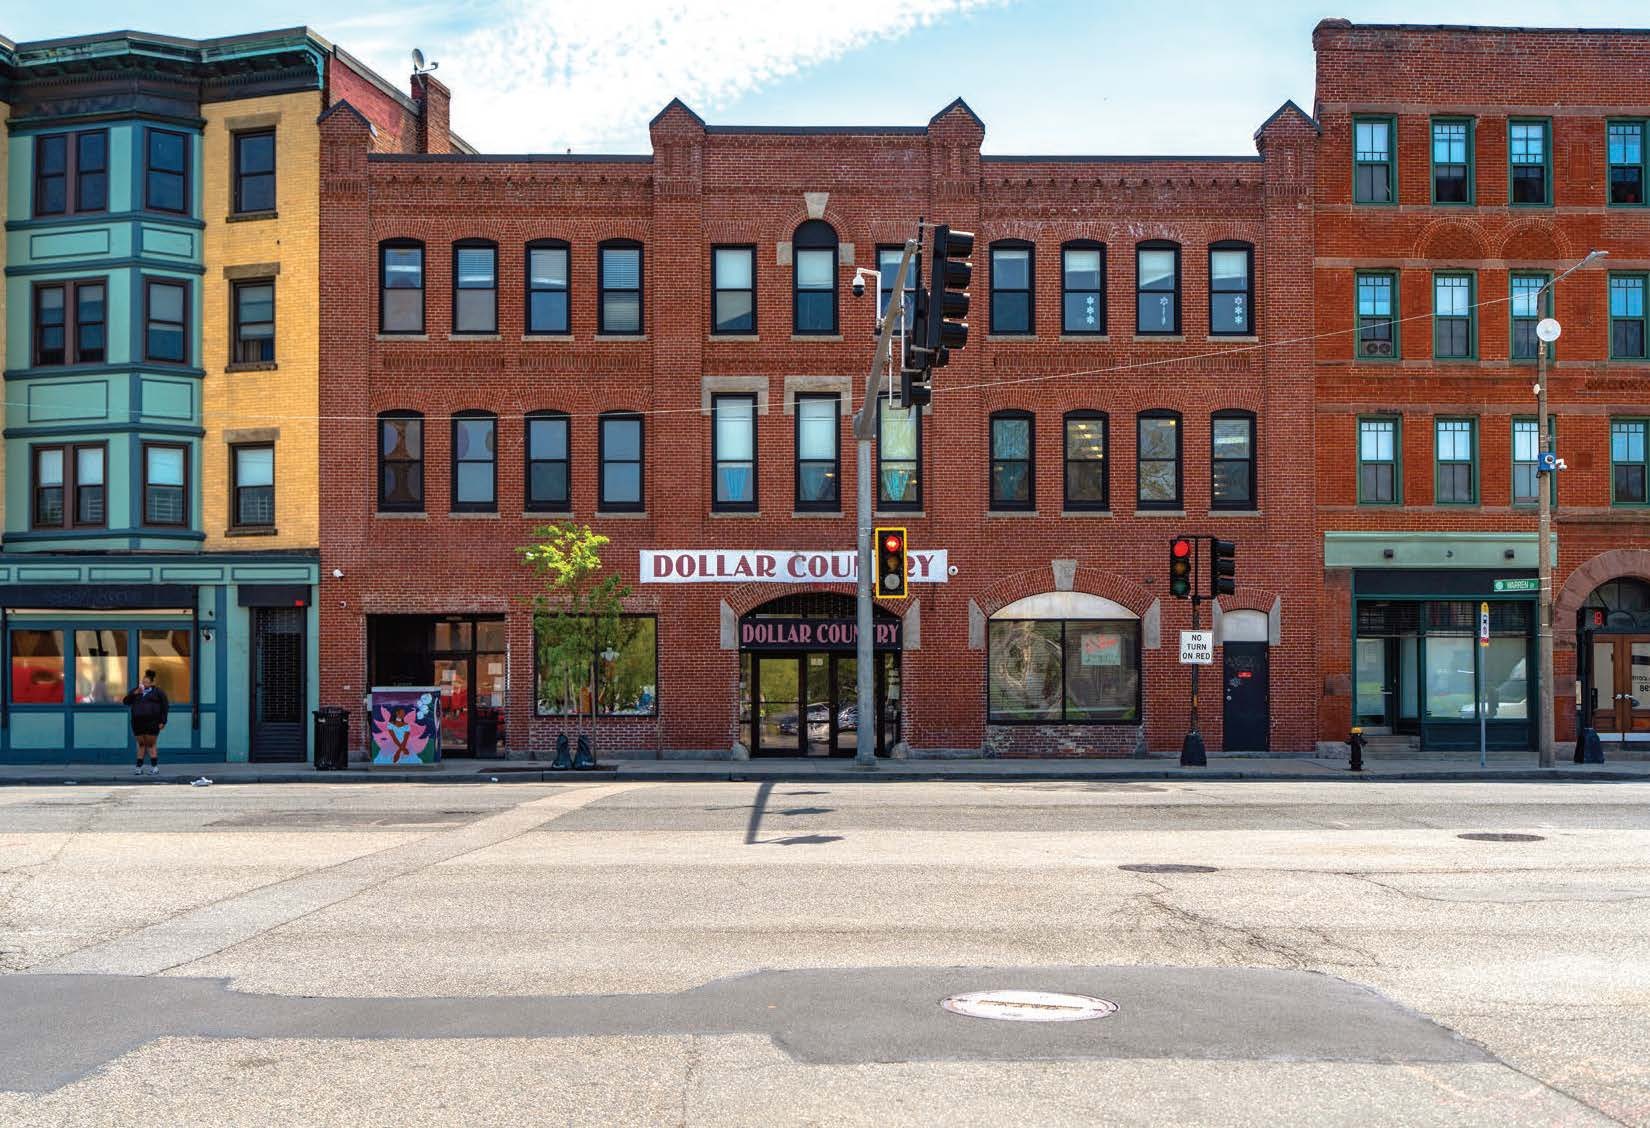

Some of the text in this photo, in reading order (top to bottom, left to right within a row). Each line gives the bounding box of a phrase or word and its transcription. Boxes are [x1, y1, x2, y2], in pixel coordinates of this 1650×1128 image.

[653, 554, 935, 577] DOLLAR COUY
[742, 624, 899, 643] DOLLAR COURY
[1195, 652, 1210, 660] RED
